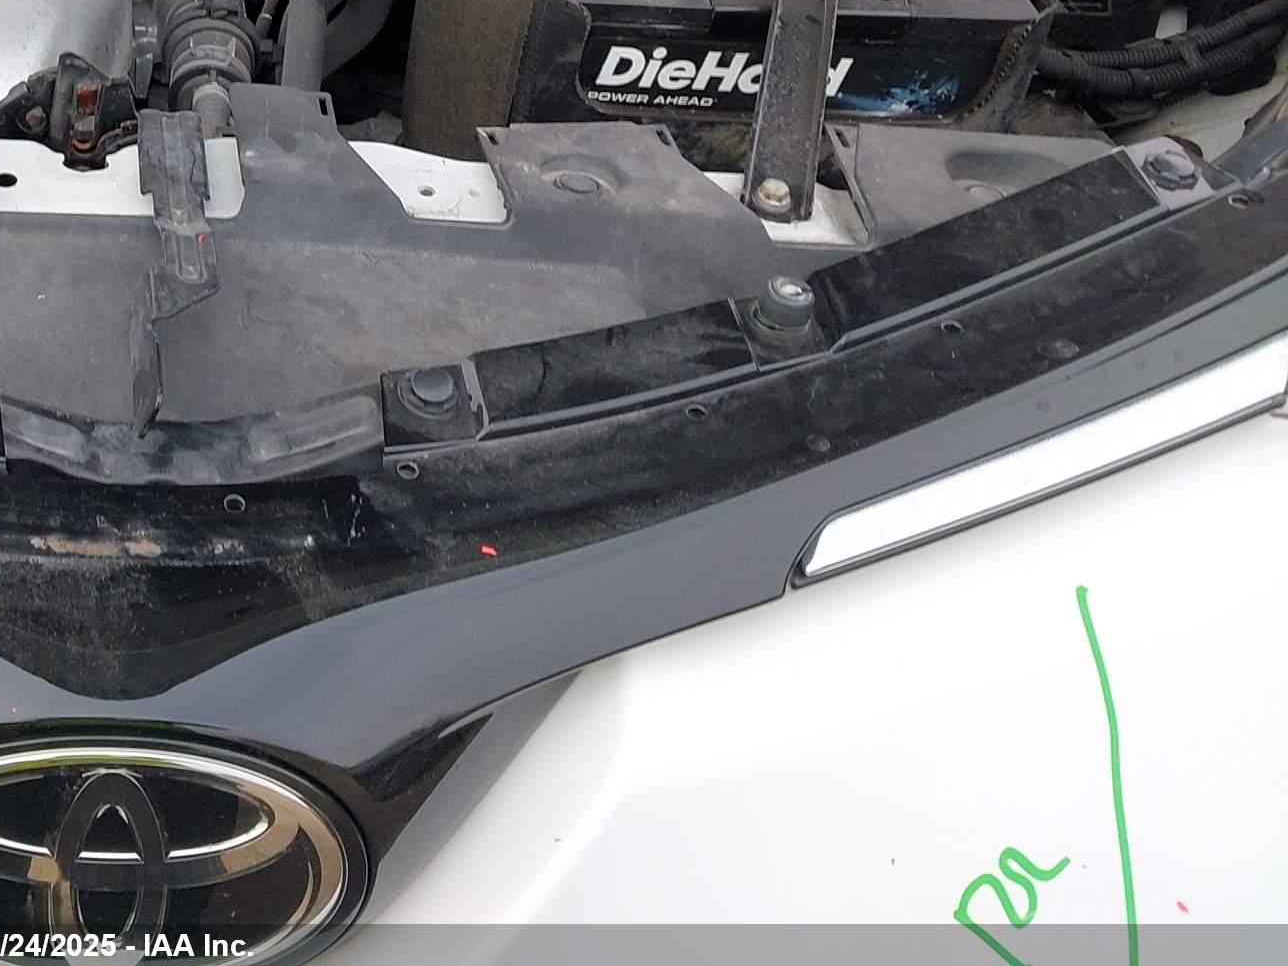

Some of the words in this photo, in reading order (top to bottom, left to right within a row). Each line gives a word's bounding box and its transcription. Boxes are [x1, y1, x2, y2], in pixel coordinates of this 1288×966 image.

[595, 45, 854, 98] DieHad
[588, 90, 650, 104] POWER
[653, 94, 713, 107] AHEAD
